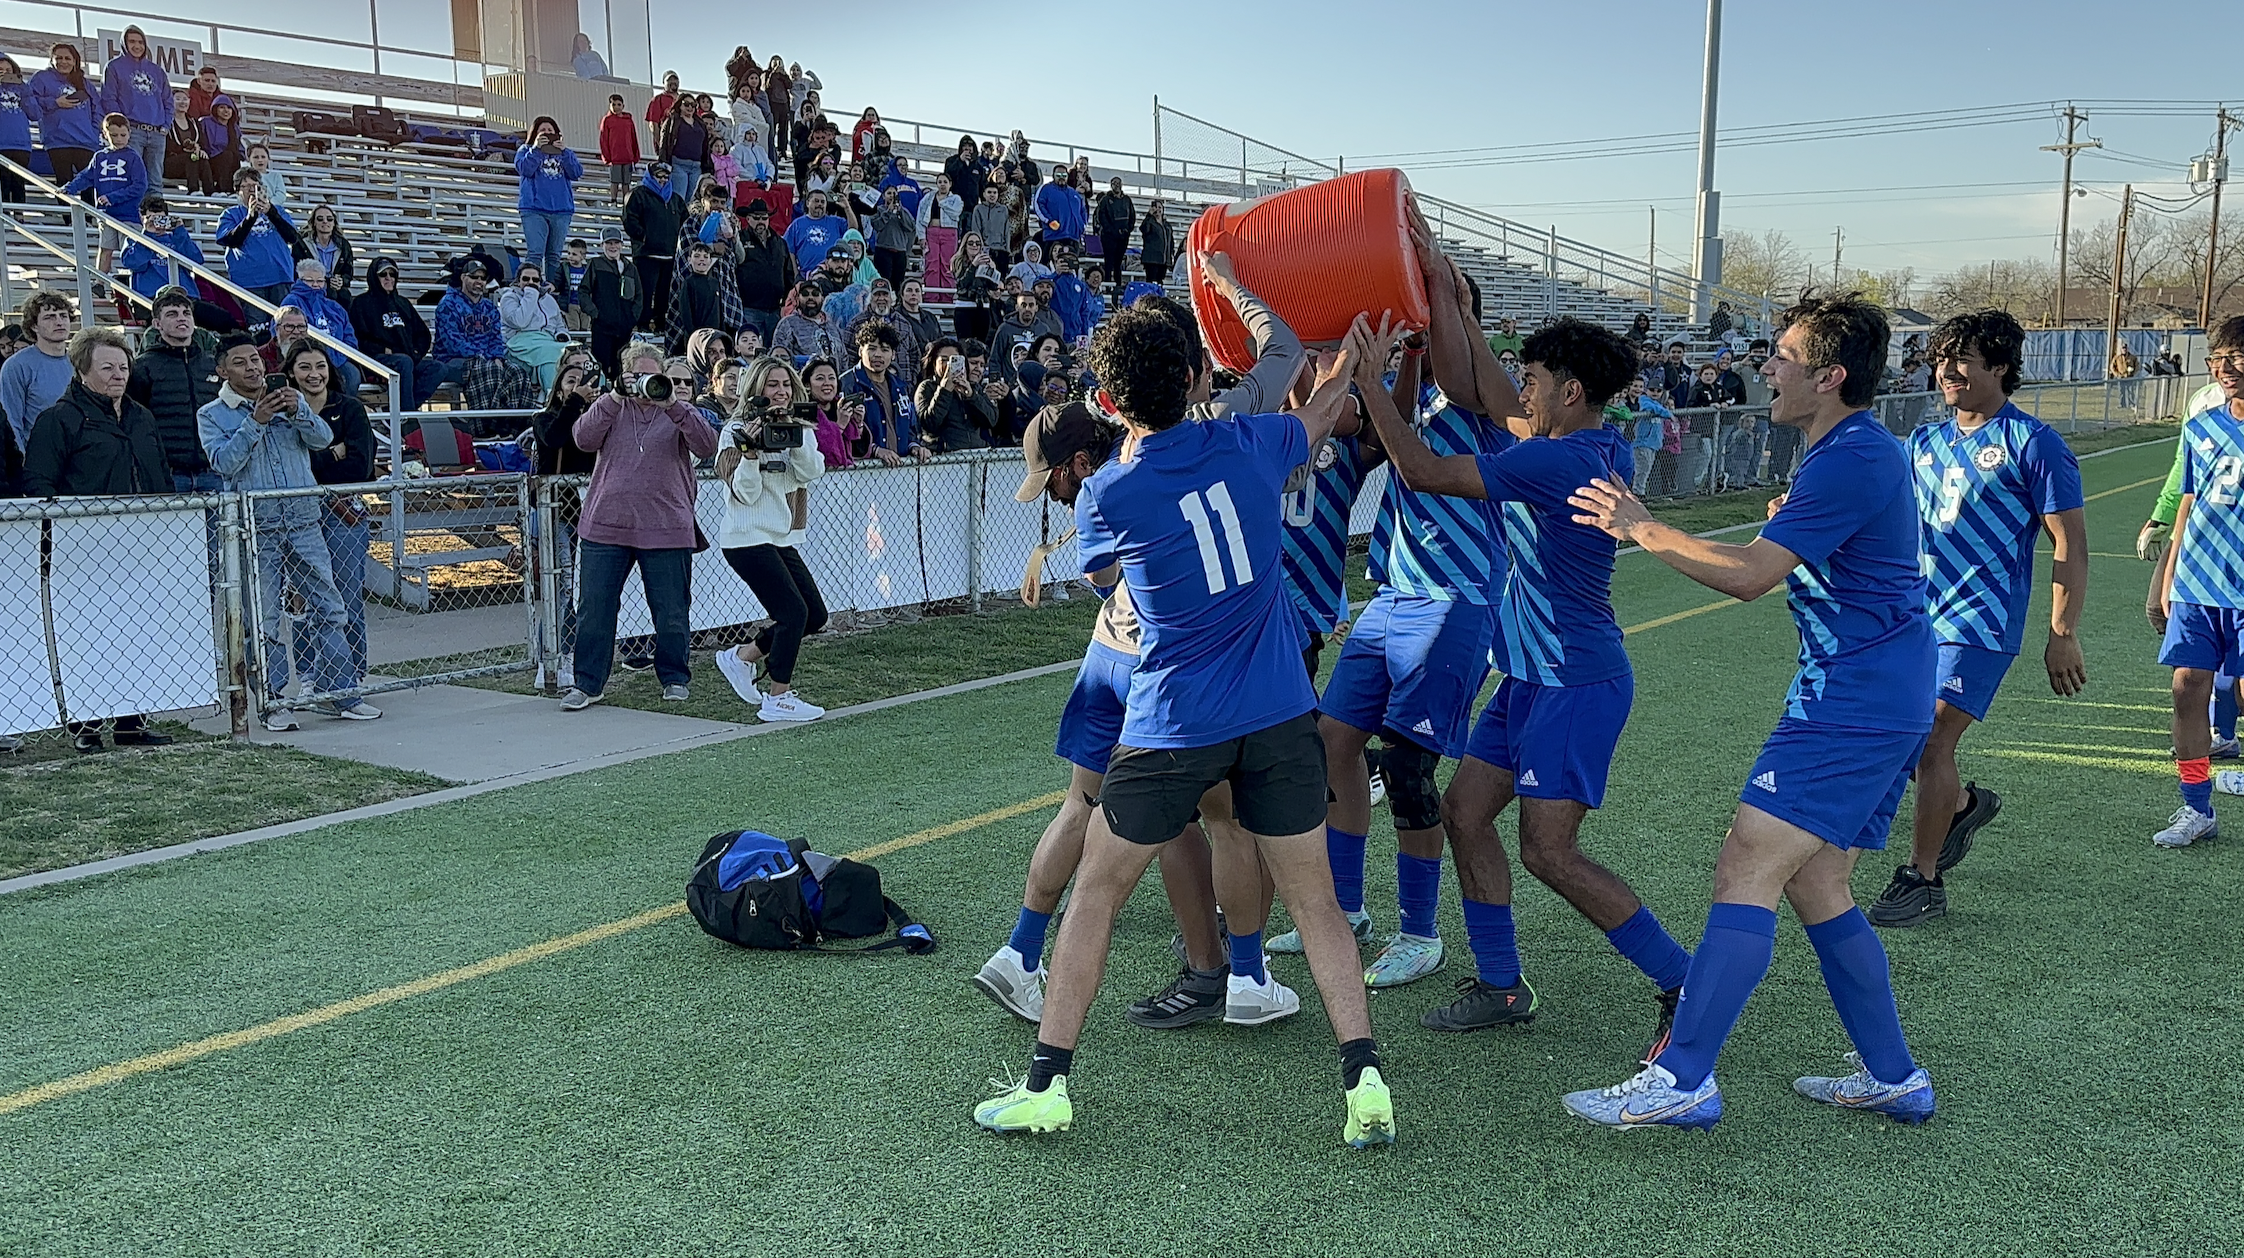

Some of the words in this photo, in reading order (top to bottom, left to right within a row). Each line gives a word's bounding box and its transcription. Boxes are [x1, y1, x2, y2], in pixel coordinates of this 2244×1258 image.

[1939, 467, 1965, 522] 5
[1178, 480, 1254, 595] 11
[1412, 726, 1434, 736] adidas
[1752, 778, 1777, 793] adidas
